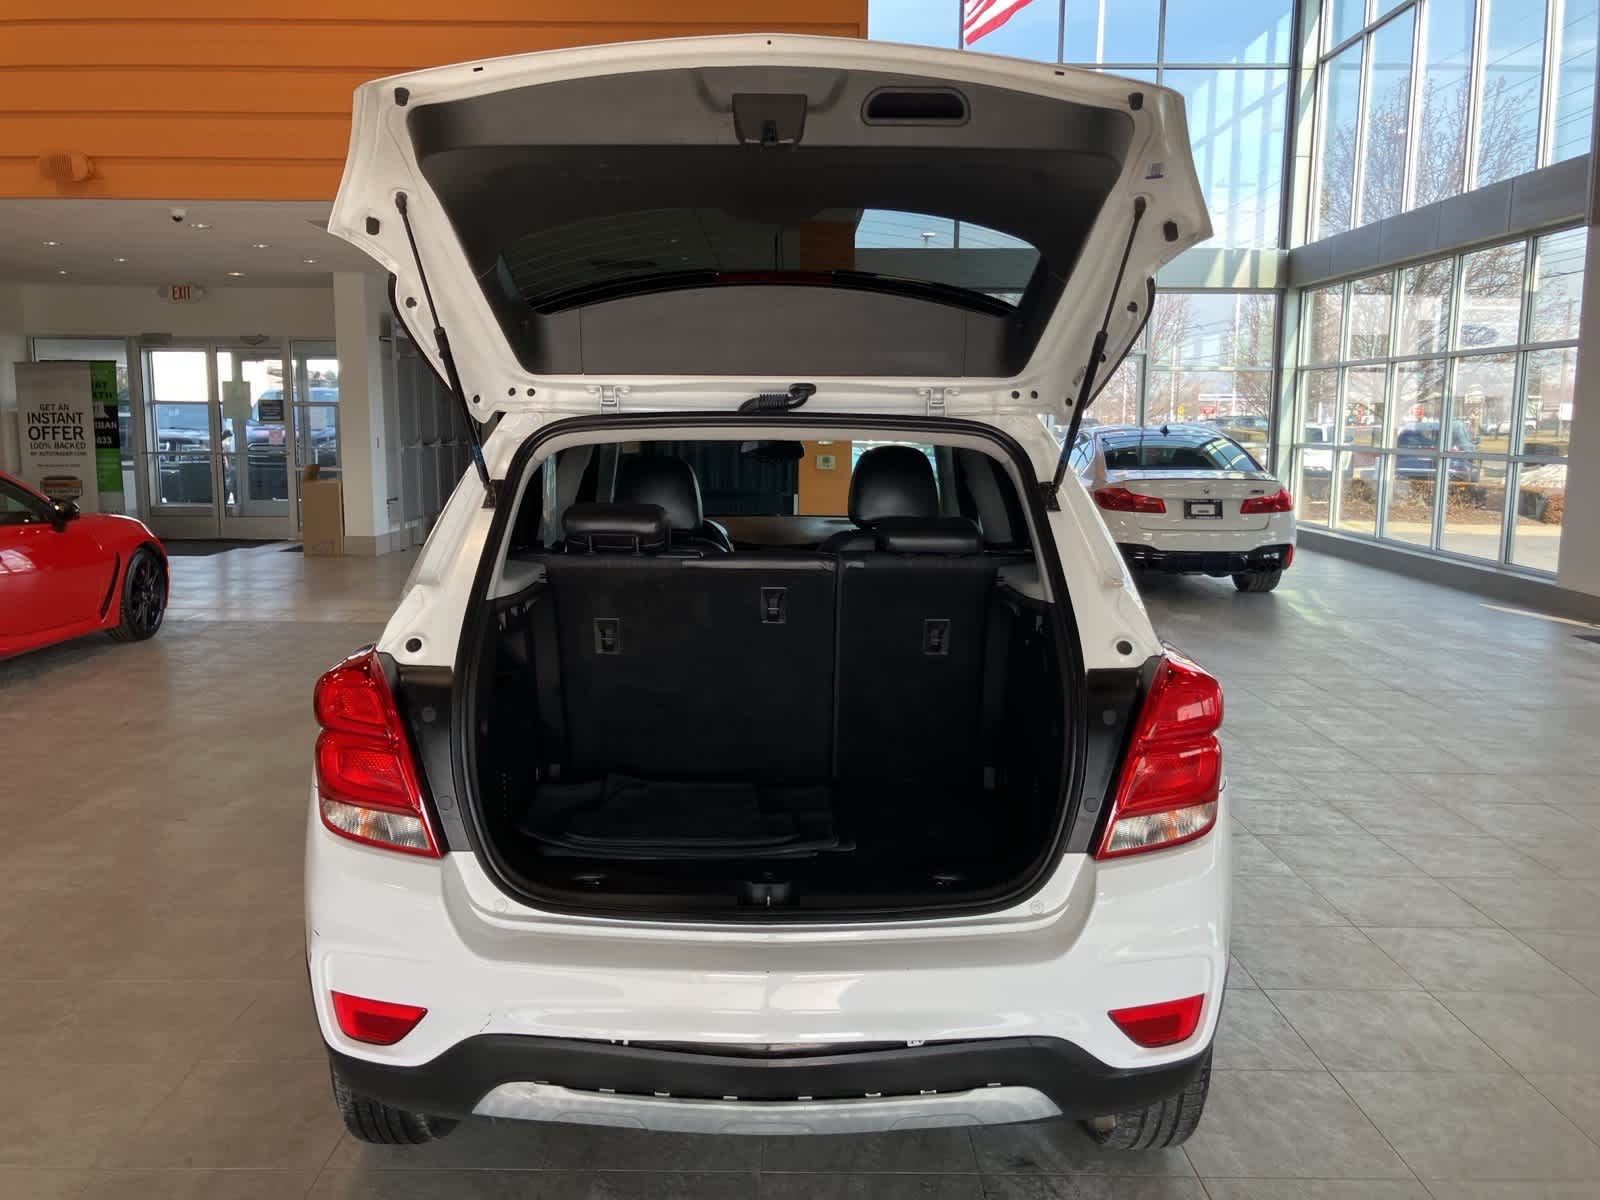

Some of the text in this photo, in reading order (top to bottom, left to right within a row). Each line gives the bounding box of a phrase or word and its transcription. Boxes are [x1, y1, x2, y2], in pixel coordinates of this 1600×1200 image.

[172, 285, 192, 300] EXIT
[40, 403, 70, 411] GET AN
[27, 411, 84, 425] INSTANT
[28, 426, 85, 441] OFFER
[30, 441, 87, 450] 100% BACKED
